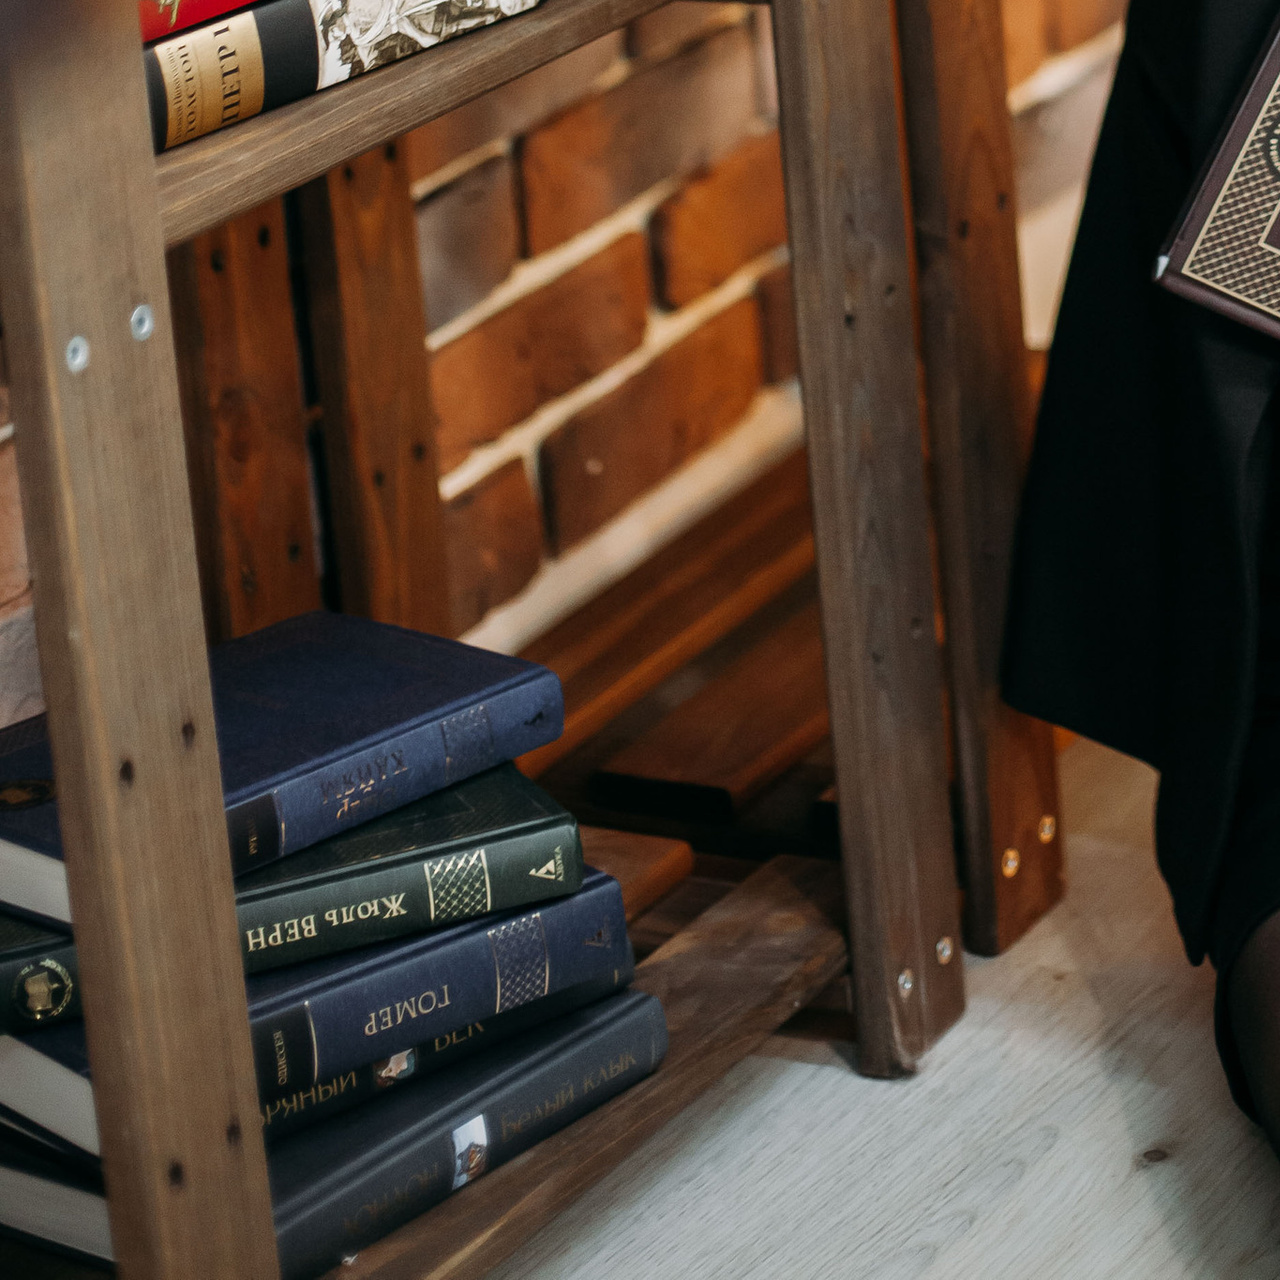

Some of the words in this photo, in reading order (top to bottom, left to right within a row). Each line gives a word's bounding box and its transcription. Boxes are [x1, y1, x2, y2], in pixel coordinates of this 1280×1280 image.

[178, 44, 197, 135] ТОЛСТОЙ
[218, 45, 241, 123] ПЕТР
[247, 914, 318, 952] ВЕРН
[325, 893, 407, 928] Жюль
[364, 983, 451, 1037] ГОМЕР
[273, 1030, 290, 1086] ОДИССЕЯ
